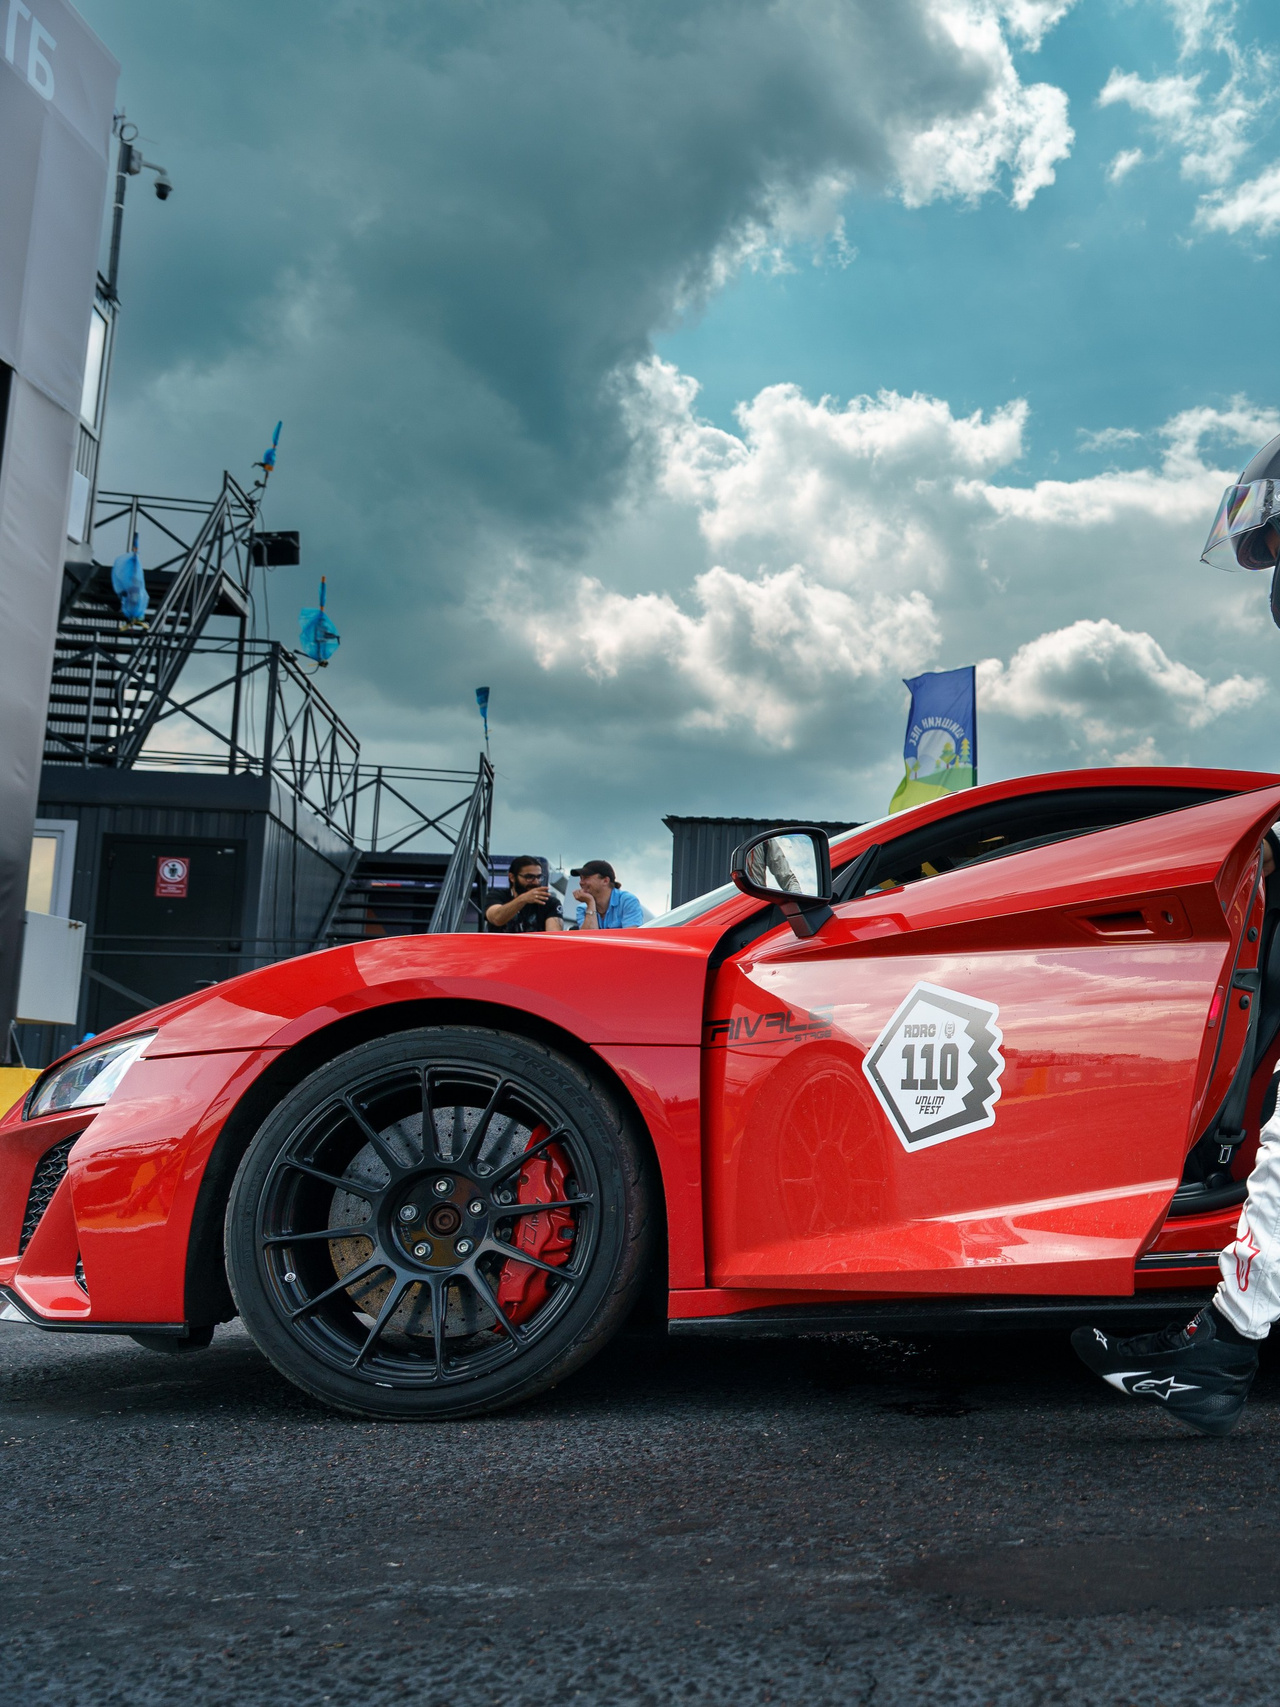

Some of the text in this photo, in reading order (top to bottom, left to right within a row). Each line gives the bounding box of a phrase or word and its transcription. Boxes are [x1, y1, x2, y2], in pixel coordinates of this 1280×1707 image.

[704, 1004, 833, 1042] RIVALS
[794, 1030, 832, 1042] STAGE
[904, 1024, 936, 1038] RDRC
[901, 1043, 959, 1090] 110
[511, 1052, 590, 1108] PROXES
[919, 1105, 941, 1114] FEST
